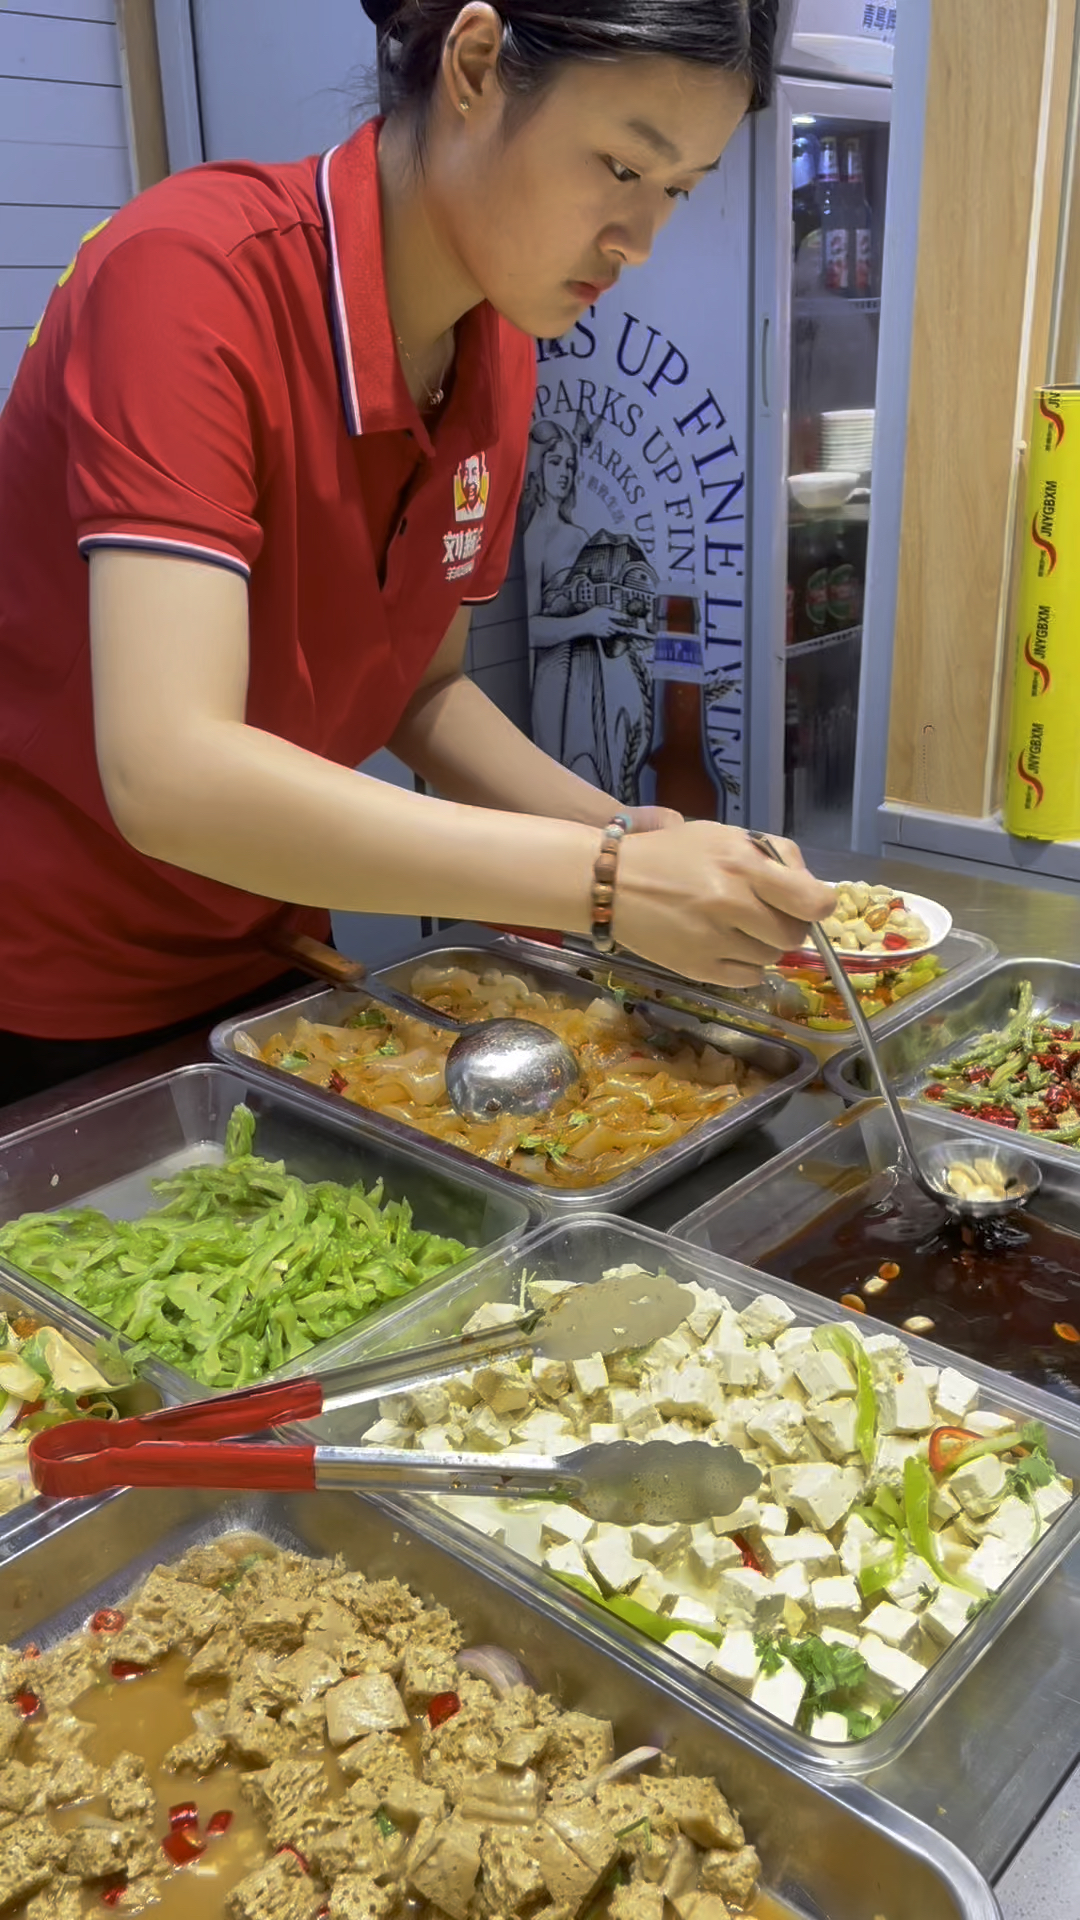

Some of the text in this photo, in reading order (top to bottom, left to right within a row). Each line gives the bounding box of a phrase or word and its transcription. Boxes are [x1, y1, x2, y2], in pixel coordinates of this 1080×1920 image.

[617, 311, 689, 398] UP
[673, 388, 744, 577] FINE
[634, 510, 656, 555] UP
[642, 426, 683, 484] UP
[664, 493, 695, 585] FIN
[1040, 480, 1057, 537] JNYGBXM
[1034, 604, 1051, 660] JNYGBXM
[1028, 722, 1045, 775] JNYGBXM
